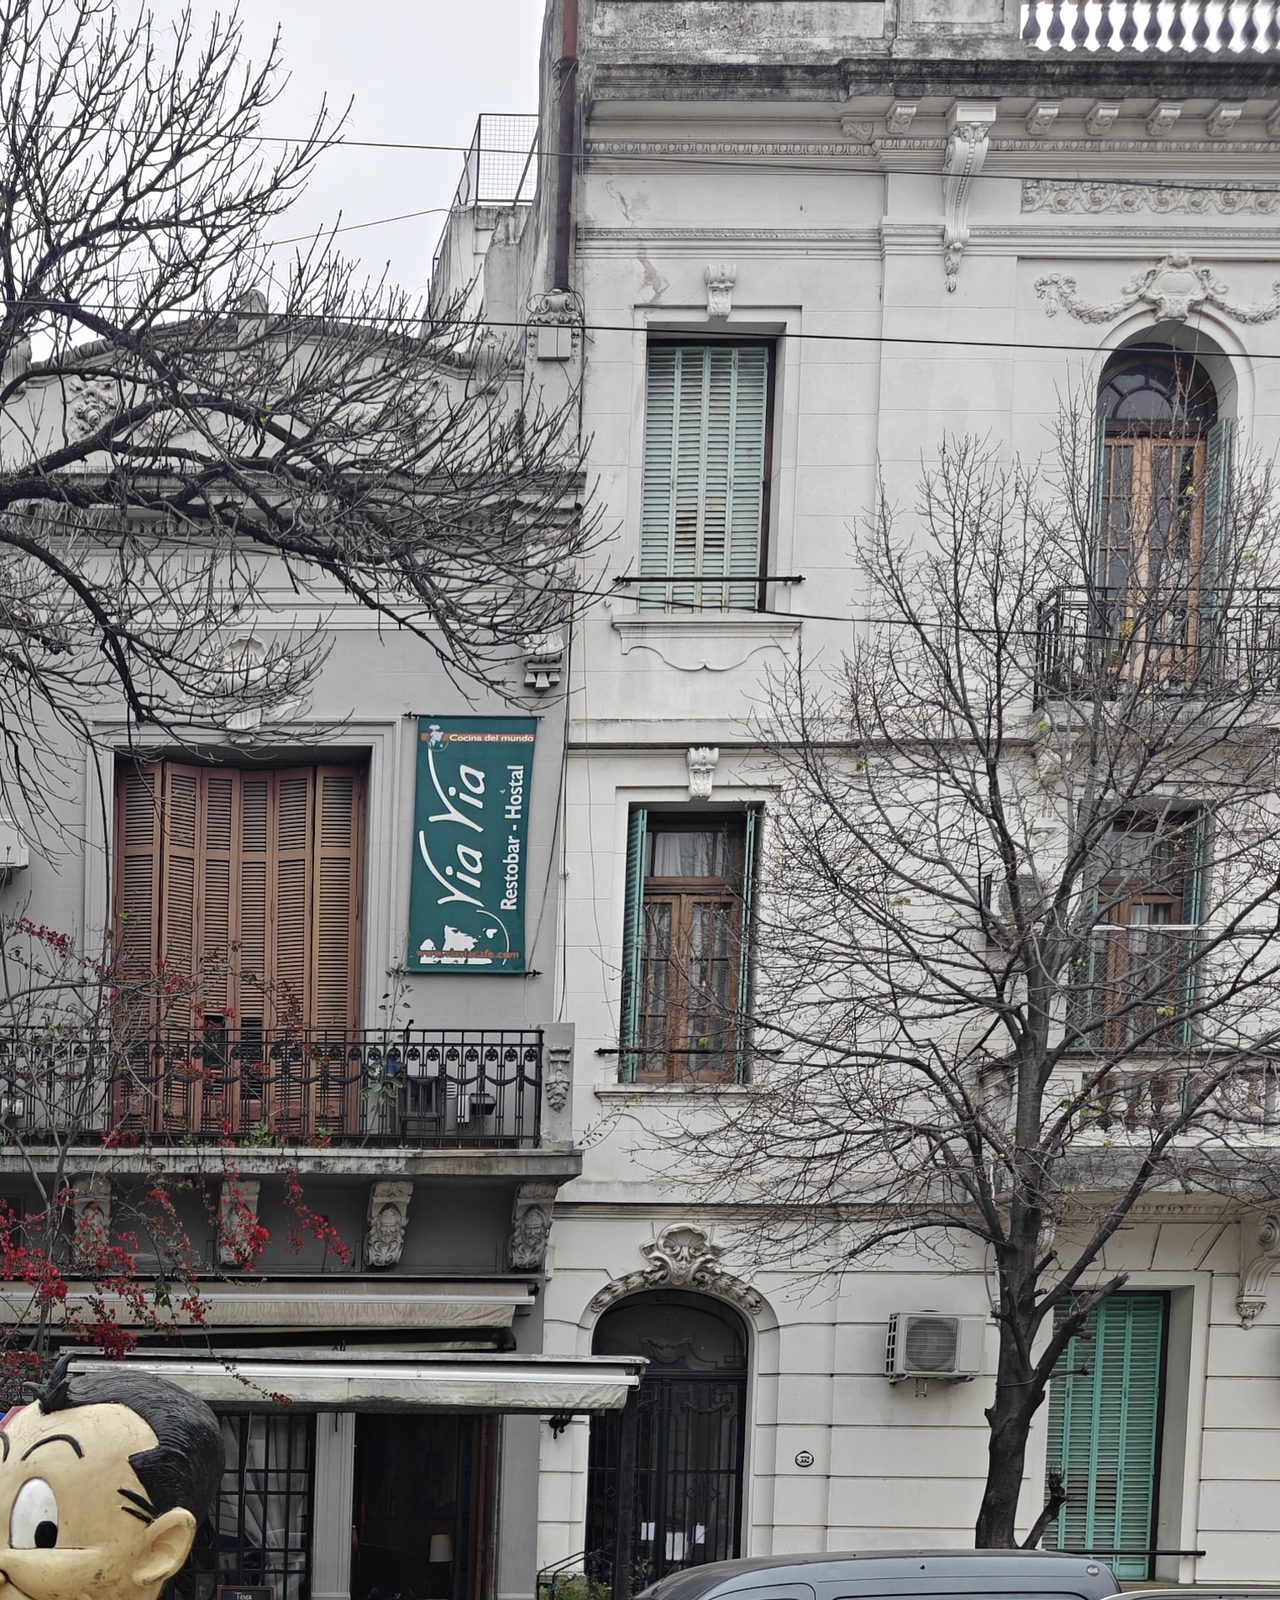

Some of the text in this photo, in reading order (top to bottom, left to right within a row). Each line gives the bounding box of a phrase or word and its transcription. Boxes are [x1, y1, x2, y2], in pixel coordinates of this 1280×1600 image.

[449, 733, 534, 742] Cocina del mundo
[504, 764, 524, 819] Hostal
[500, 835, 521, 911] Restobar
